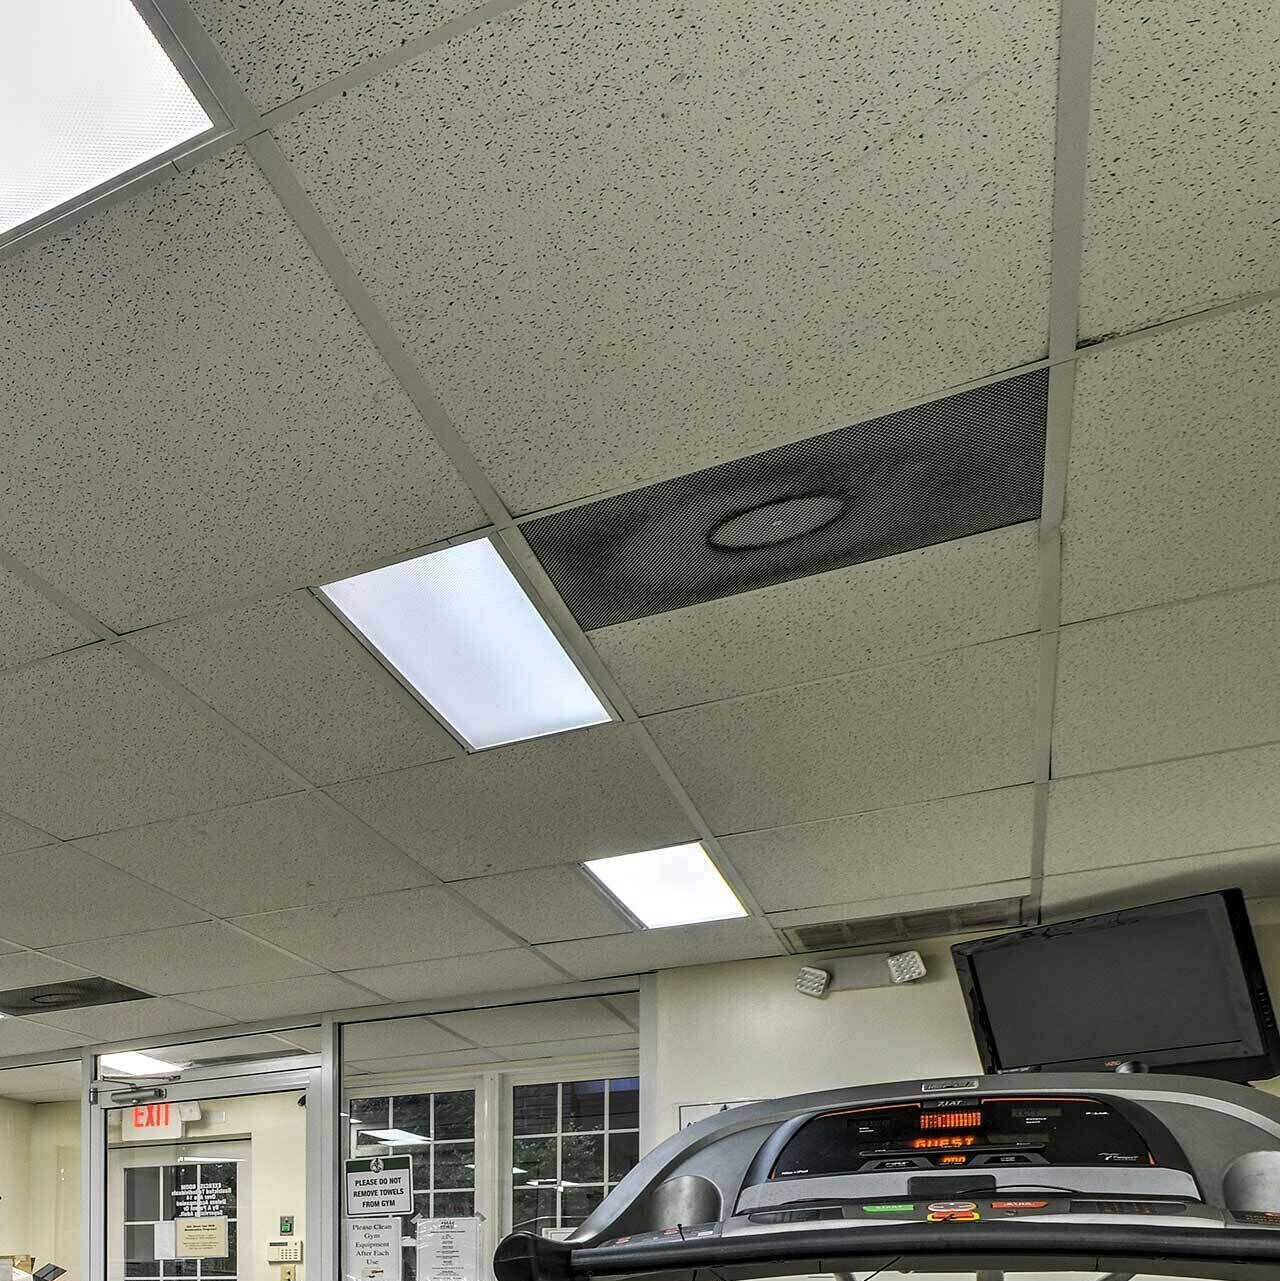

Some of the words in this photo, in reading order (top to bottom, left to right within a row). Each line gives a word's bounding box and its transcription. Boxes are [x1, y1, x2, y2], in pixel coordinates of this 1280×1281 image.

[133, 1104, 170, 1128] EXIT
[355, 1178, 377, 1186] PLEASE
[353, 1189, 379, 1198] REMOVE
[380, 1188, 404, 1196] TOWELS
[362, 1200, 380, 1208] FROM
[381, 1199, 395, 1207] GYM
[352, 1223, 372, 1231] Please
[363, 1232, 381, 1240] Gym
[355, 1241, 390, 1249] Equipment
